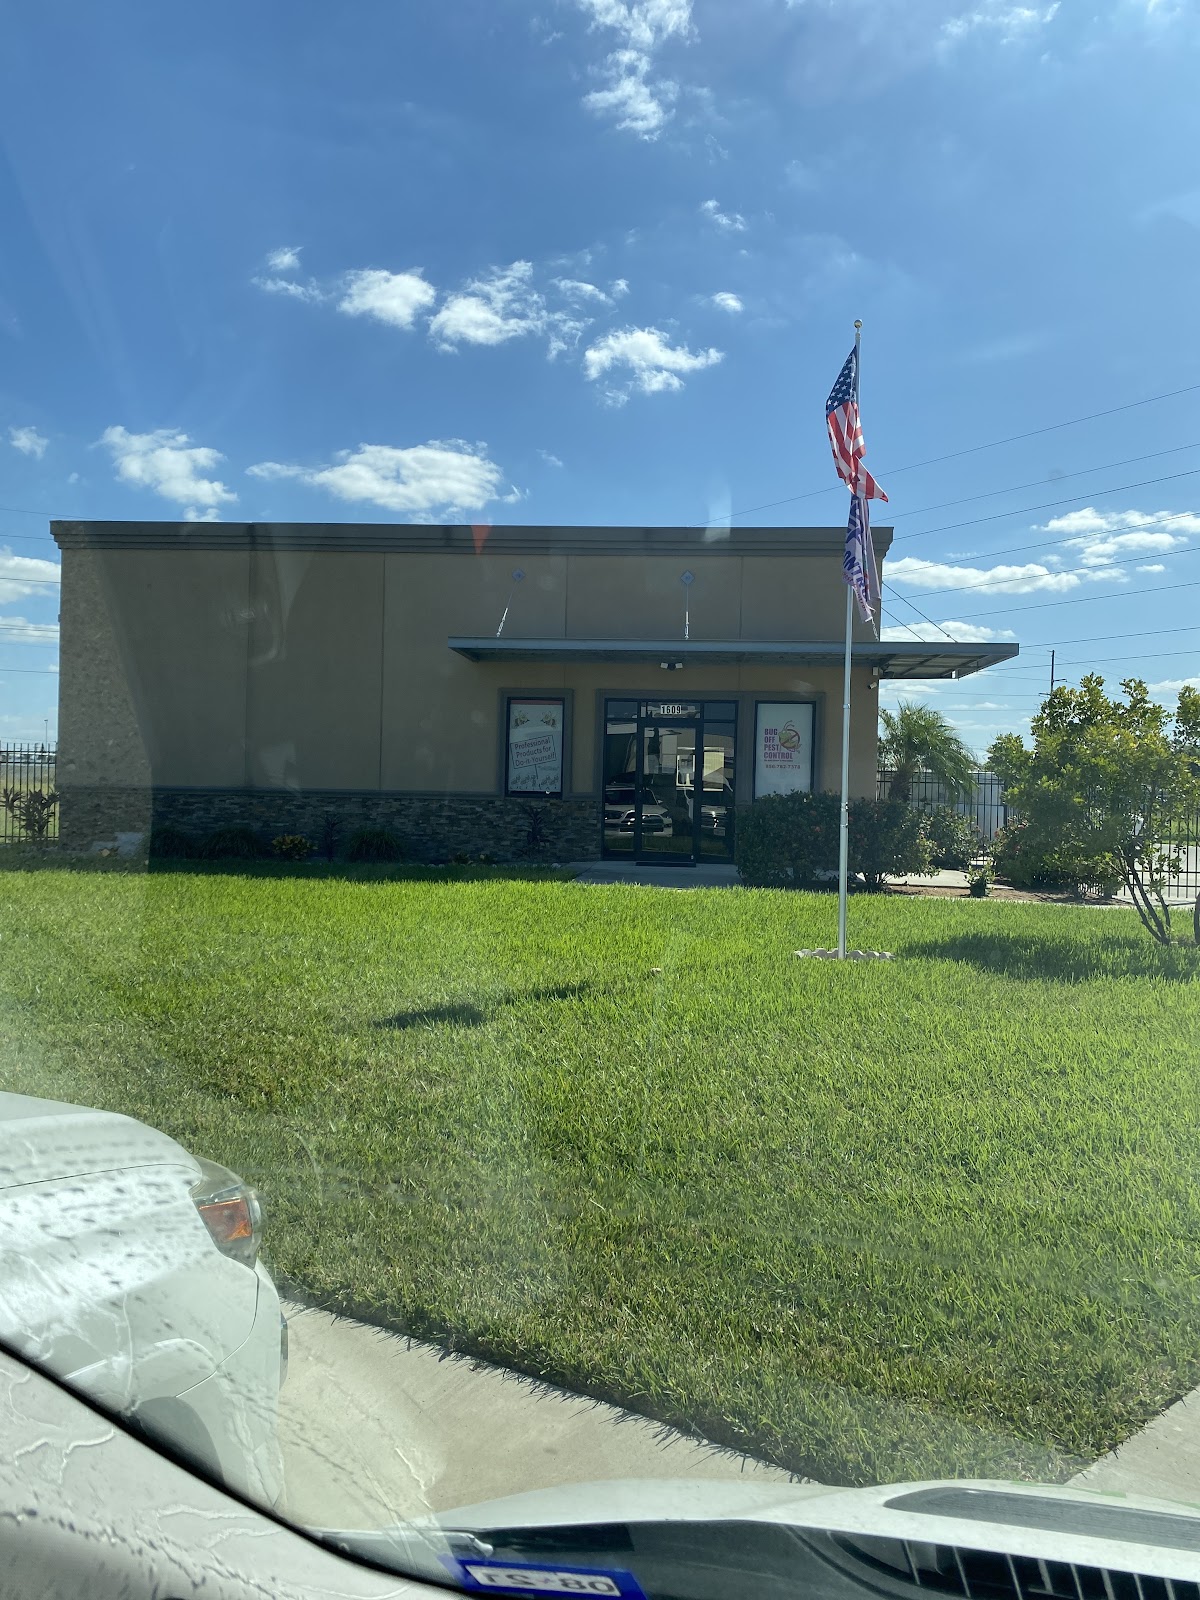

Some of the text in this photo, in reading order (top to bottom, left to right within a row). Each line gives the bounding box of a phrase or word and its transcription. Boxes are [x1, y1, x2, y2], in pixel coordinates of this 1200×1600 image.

[662, 705, 681, 713] 1609
[515, 737, 550, 749] Professional
[515, 748, 542, 758] Products
